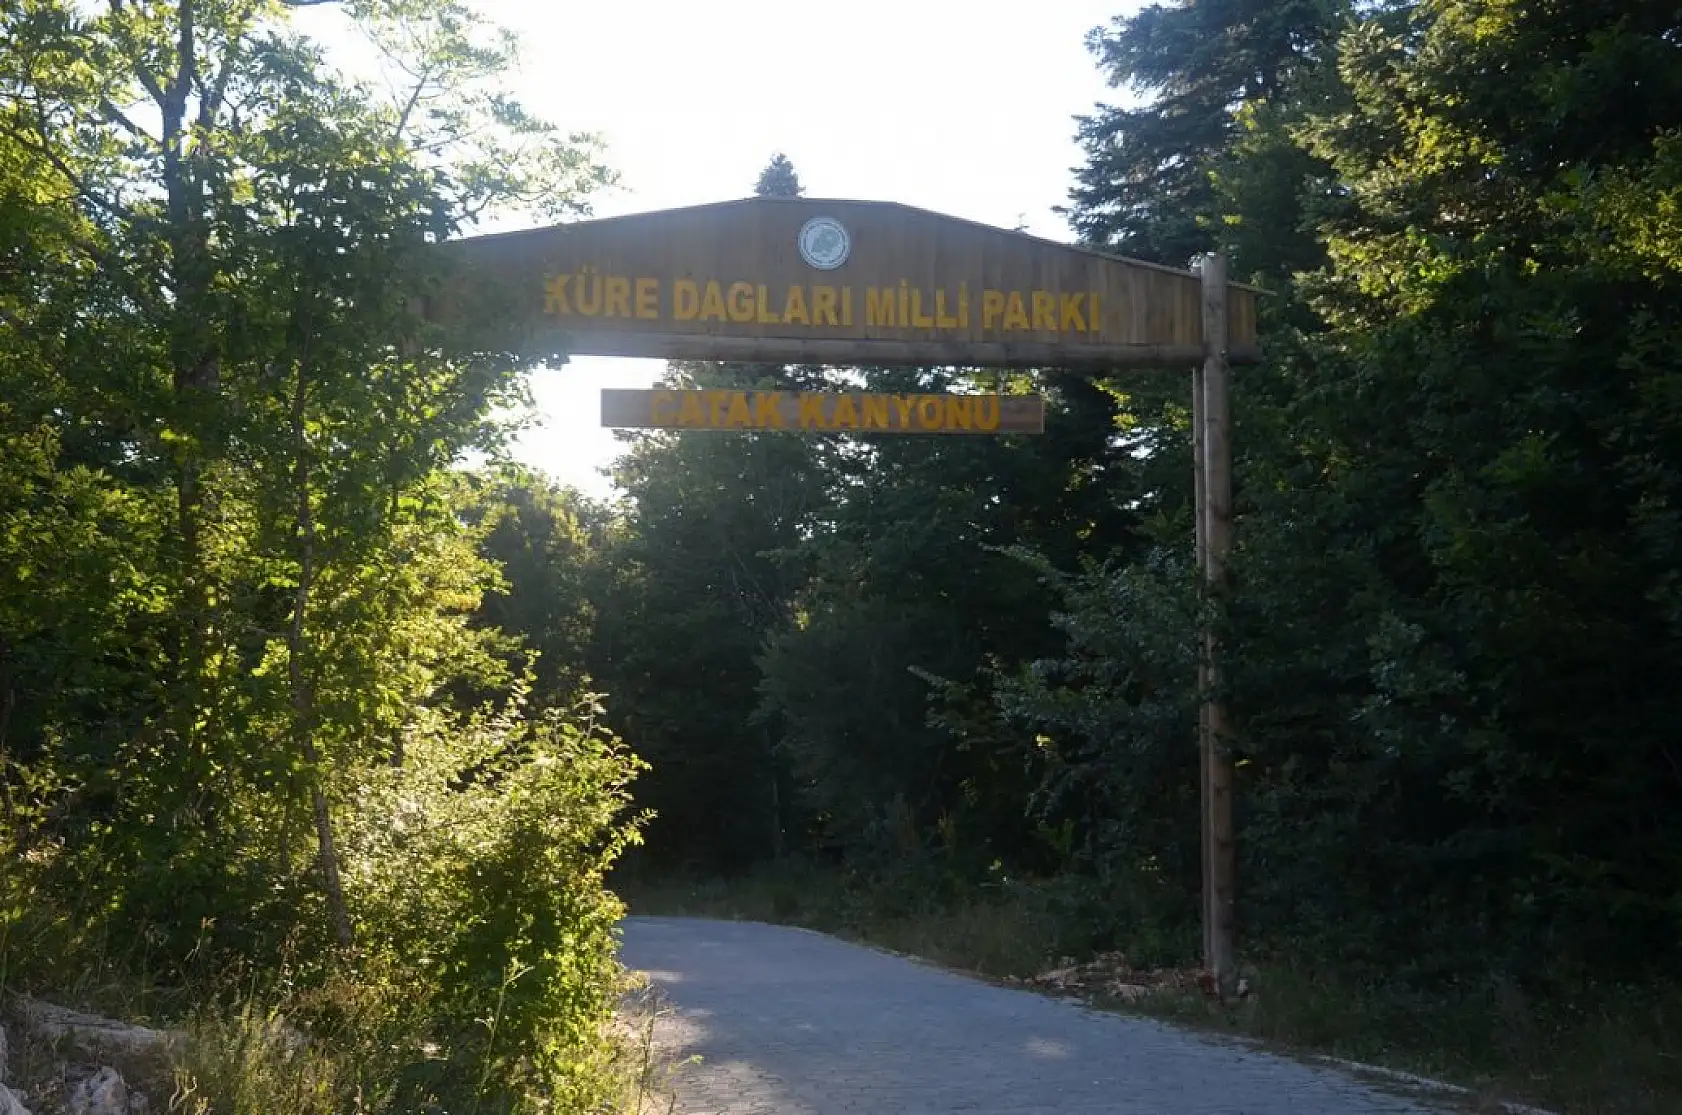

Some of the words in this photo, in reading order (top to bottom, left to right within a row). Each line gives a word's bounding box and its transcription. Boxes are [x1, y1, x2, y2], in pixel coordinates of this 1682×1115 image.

[543, 266, 660, 319] KÜRE
[865, 277, 969, 329] MİLLİ
[982, 288, 1101, 332] PARKI
[797, 392, 1001, 431] KANYONU
